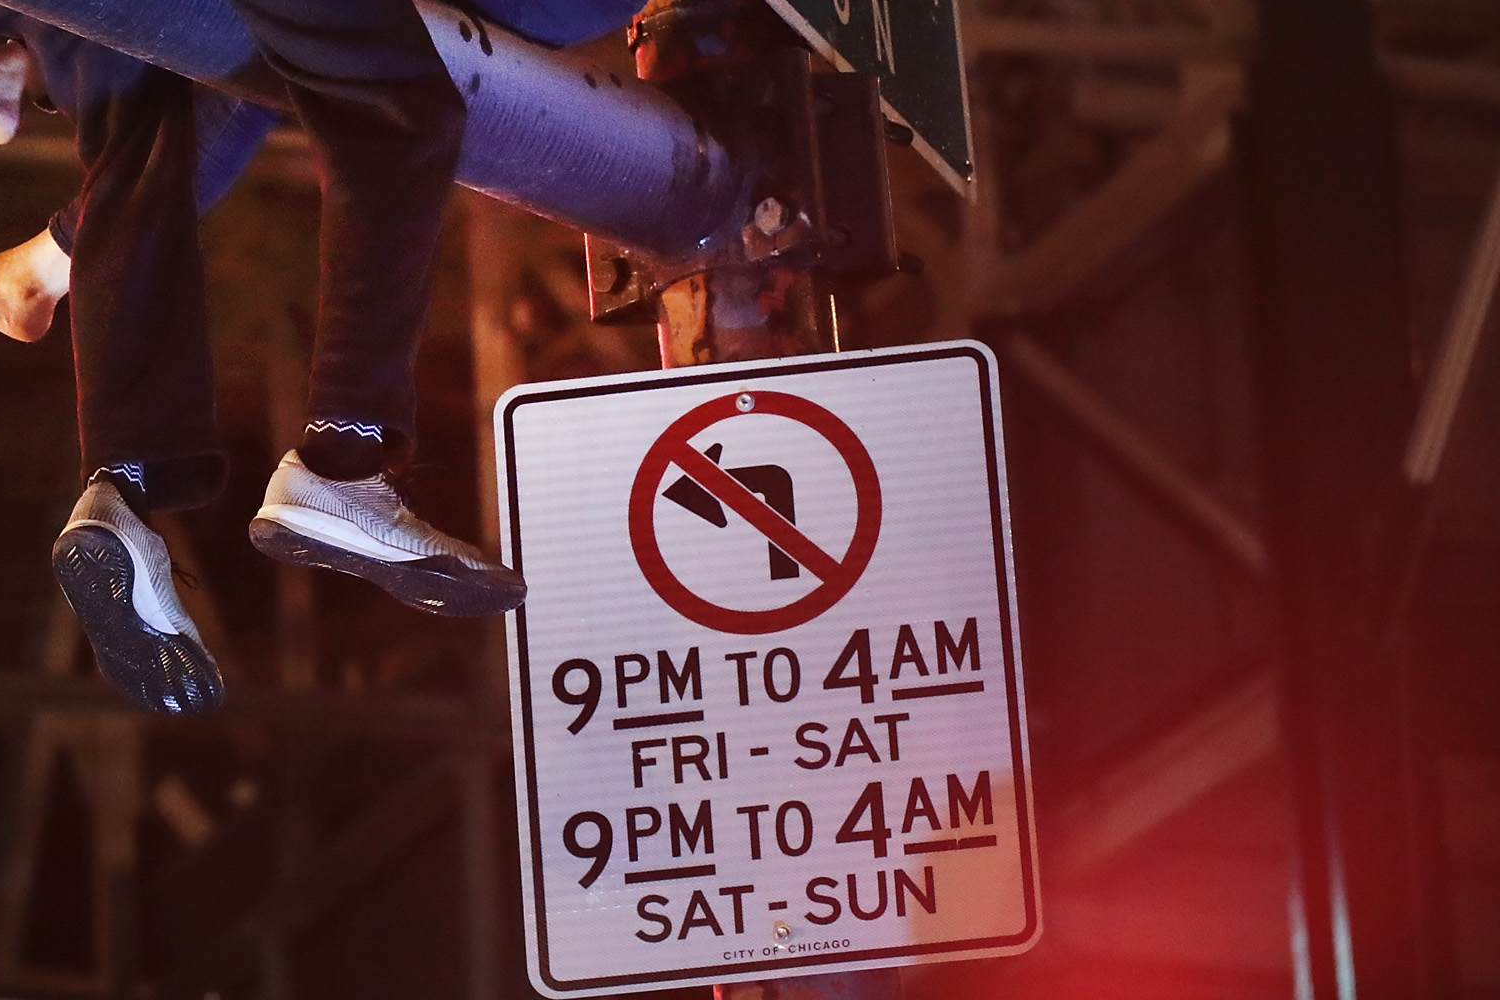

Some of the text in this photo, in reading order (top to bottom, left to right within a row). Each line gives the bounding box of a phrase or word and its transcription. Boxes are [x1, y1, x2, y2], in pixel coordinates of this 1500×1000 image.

[551, 616, 985, 736] 9PM TO 4AM
[631, 731, 729, 789] FRI
[793, 712, 910, 770] SAT
[562, 769, 998, 890] 9PM TO 4AM
[722, 938, 851, 961] CITY OF CHICAGO
